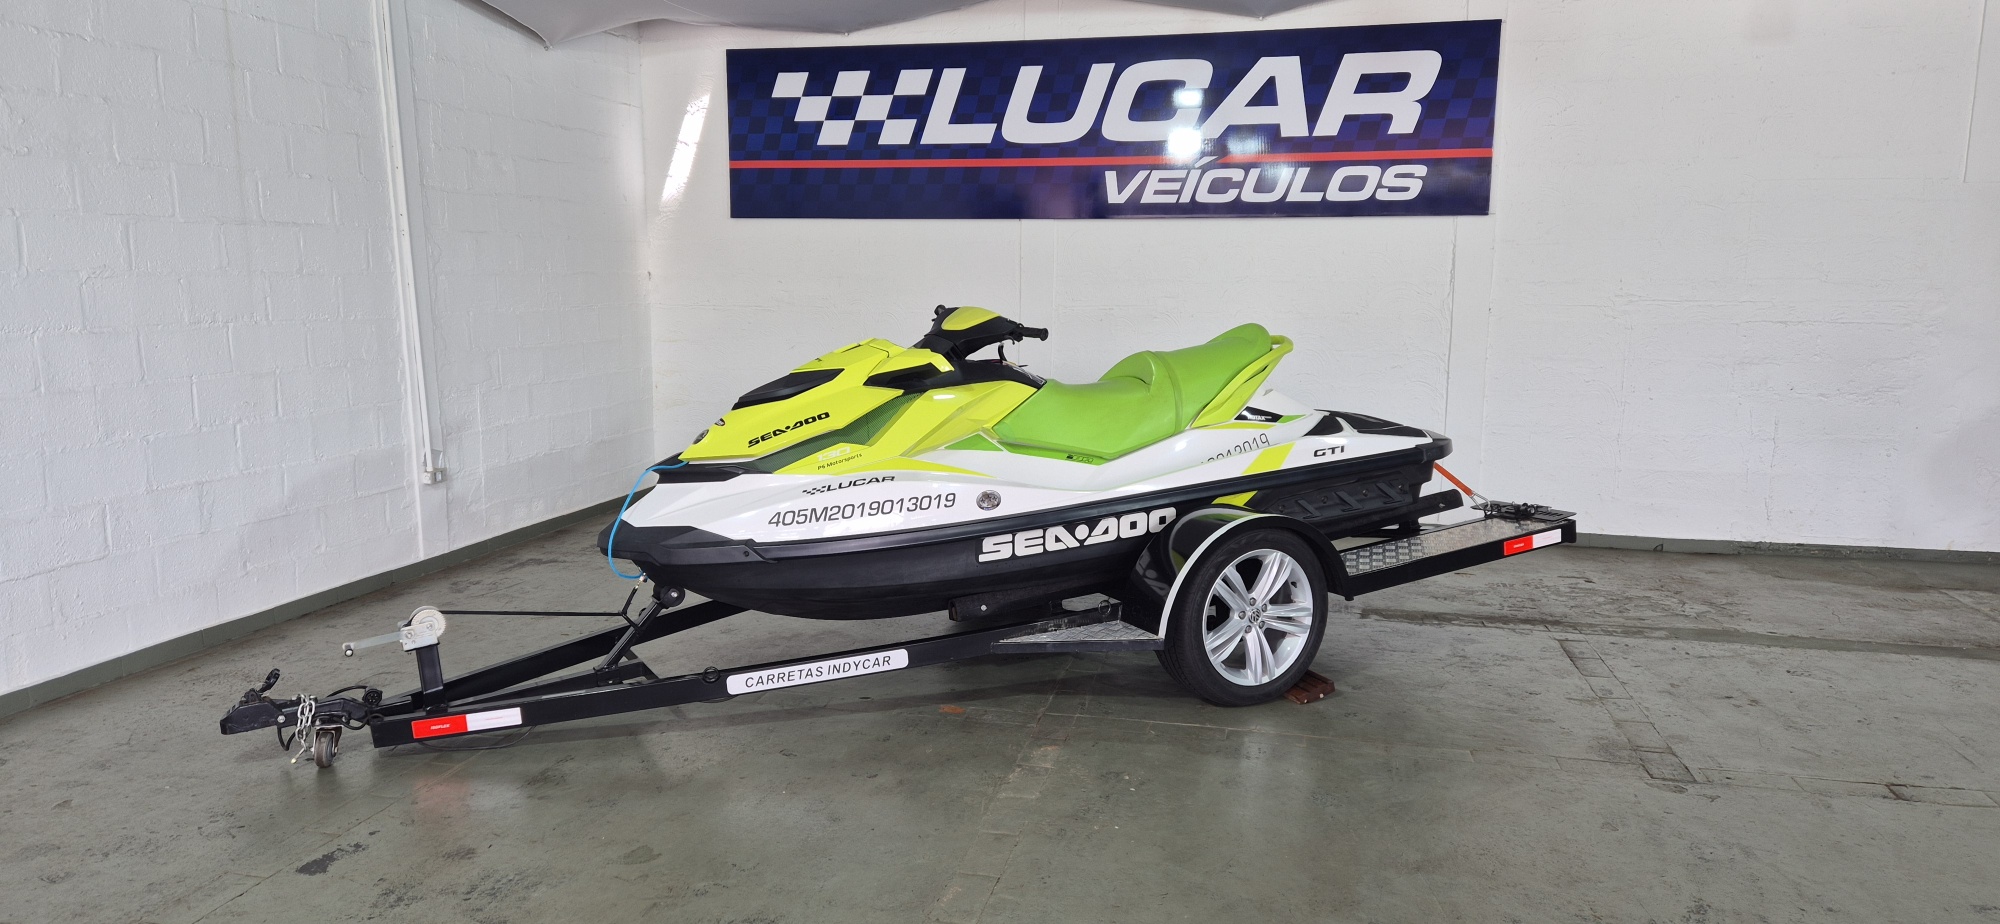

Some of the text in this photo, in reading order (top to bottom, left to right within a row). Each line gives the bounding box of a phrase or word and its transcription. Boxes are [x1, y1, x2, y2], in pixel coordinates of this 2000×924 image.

[919, 50, 1443, 145] LUCAR
[1105, 156, 1428, 204] VEÍCULOS
[826, 453, 863, 468] Motorsports
[1313, 446, 1345, 457] GTI
[826, 476, 895, 492] LUCAR
[767, 492, 957, 527] 405M2019013019
[745, 655, 891, 688] CARRETAS INDYCAR
